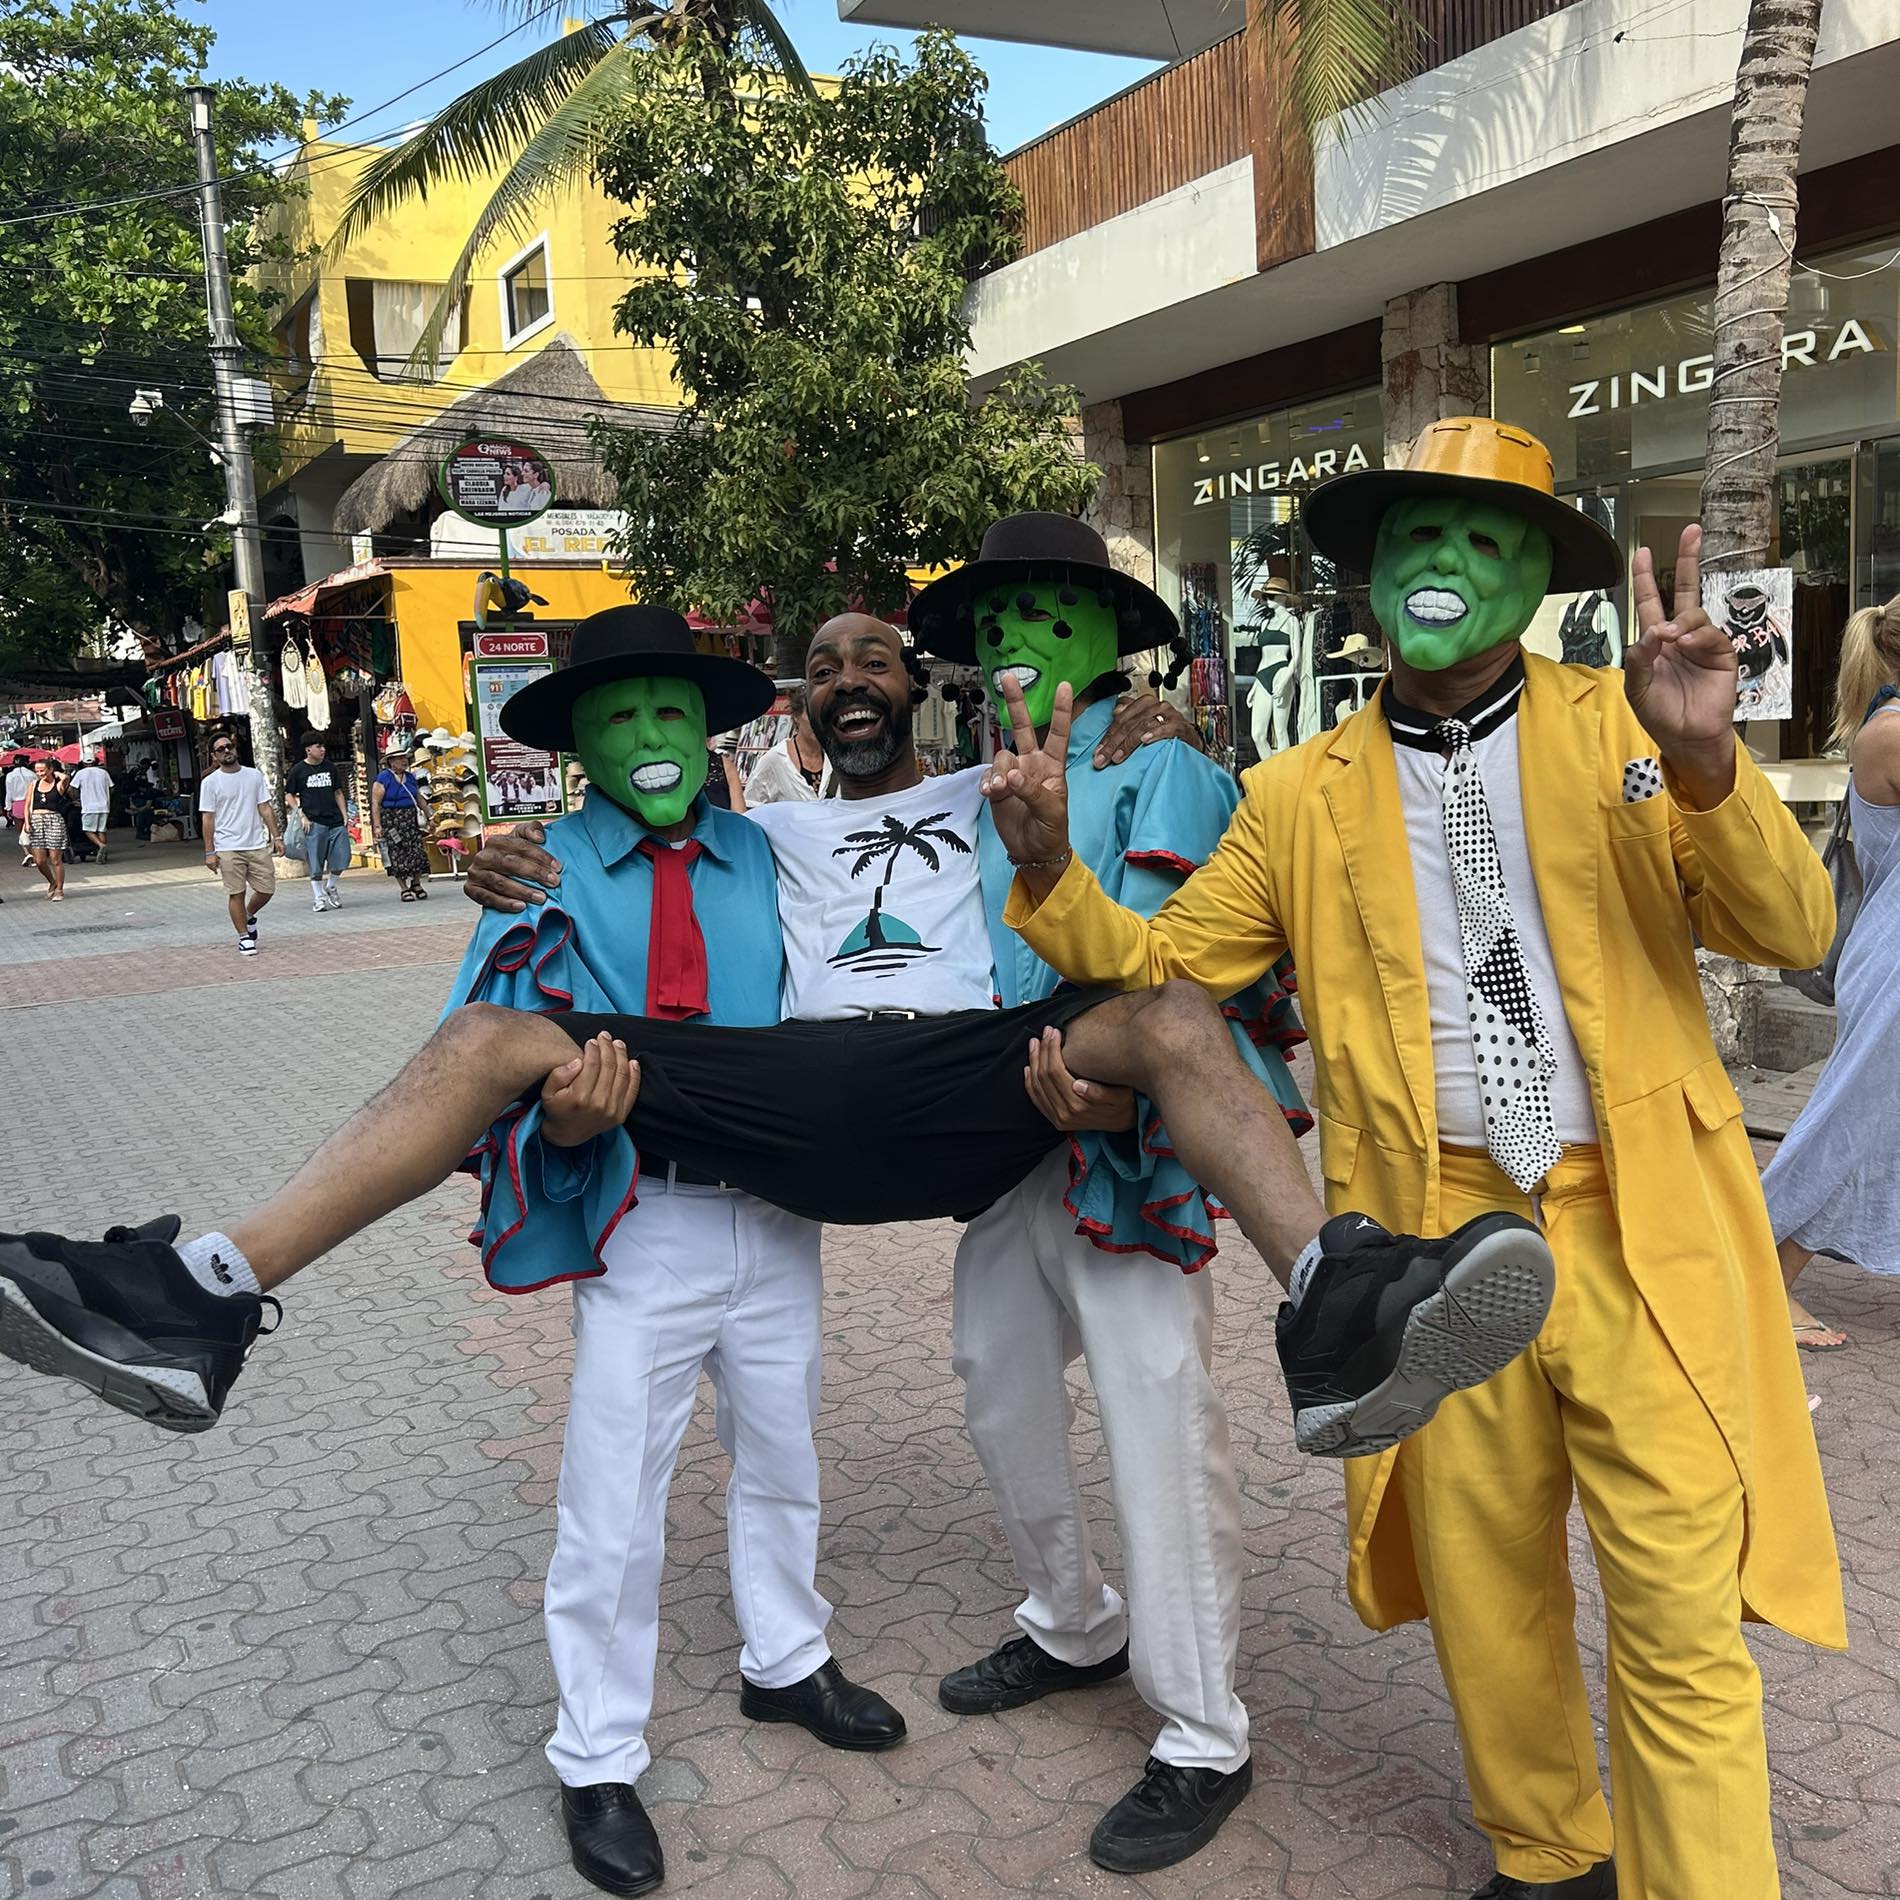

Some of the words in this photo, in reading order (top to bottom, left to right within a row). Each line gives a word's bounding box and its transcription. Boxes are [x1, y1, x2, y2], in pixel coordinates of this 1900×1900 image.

[1567, 319, 1874, 419] ZINGRA
[1193, 443, 1369, 506] ZINGARA
[552, 528, 597, 536] POSADA
[524, 536, 555, 553] EL
[489, 643, 502, 652] 24
[503, 642, 537, 652] NORTE
[158, 726, 183, 737] TECATE
